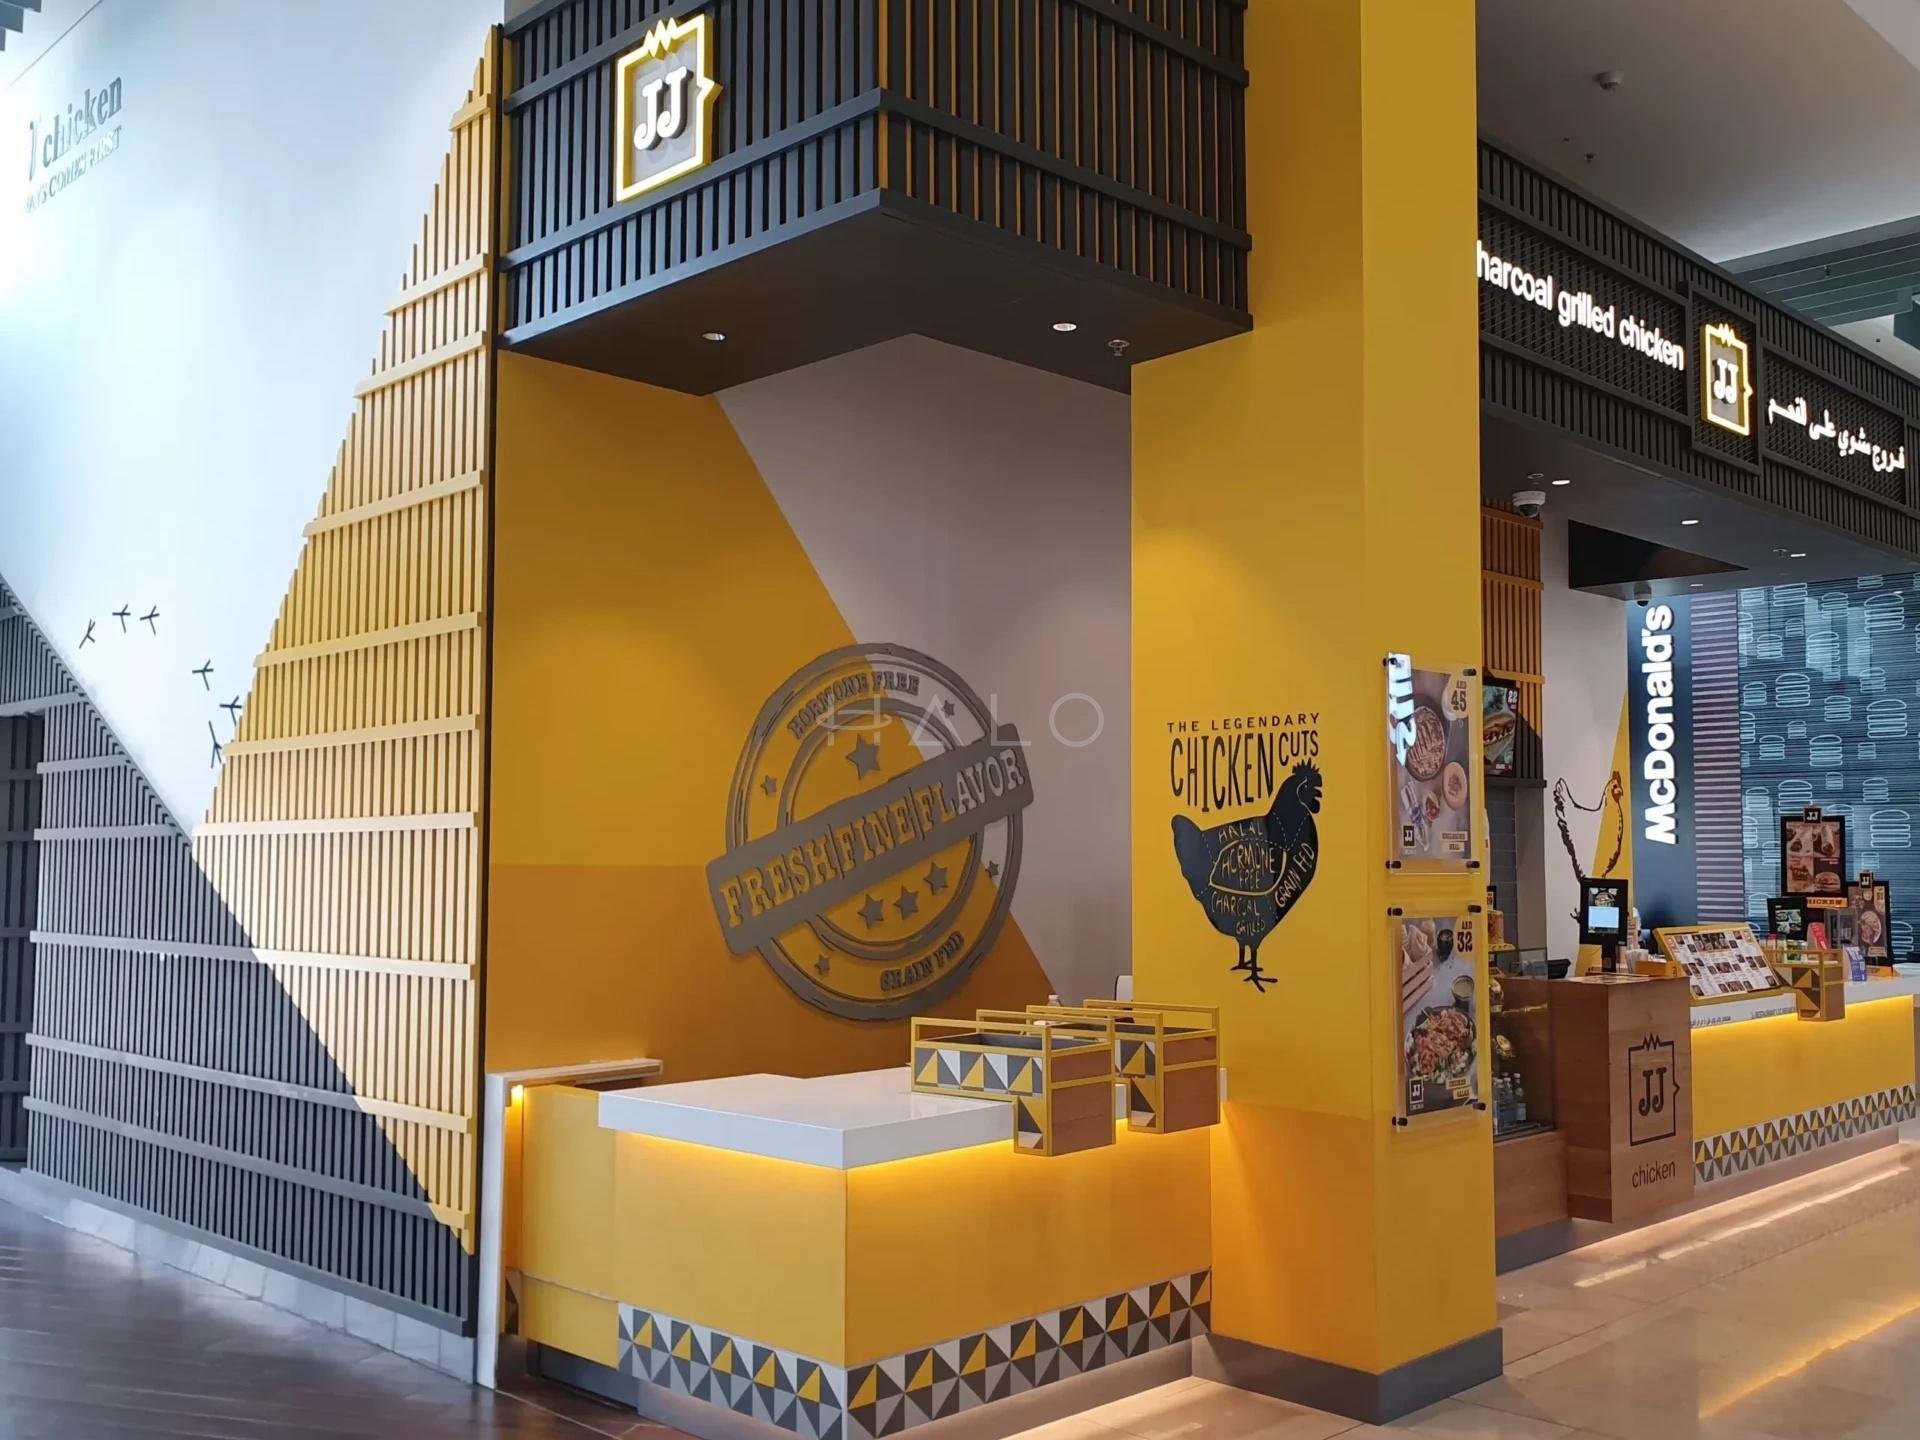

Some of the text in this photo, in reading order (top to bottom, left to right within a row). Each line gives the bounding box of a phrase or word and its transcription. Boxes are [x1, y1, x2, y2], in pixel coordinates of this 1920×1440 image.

[43, 76, 122, 168] chicken
[633, 66, 687, 150] JJ
[1557, 290, 1615, 338] grilled
[1618, 314, 1685, 371] chicken
[1713, 357, 1739, 404] JJ
[1809, 408, 1836, 440] على
[1838, 426, 1871, 457] مشوي
[1871, 445, 1905, 473] فروج
[871, 671, 921, 697] FREE
[1451, 689, 1467, 712] 45
[1167, 712, 1320, 733] THE LEGENDARY
[1641, 604, 1677, 845] McDonald's
[1170, 729, 1320, 812] CHICKEN CUTS
[719, 748, 1025, 929] FRESH FINE FLAVOR
[1218, 820, 1263, 842] HALAL
[1221, 842, 1276, 878] HORMONE
[1274, 842, 1315, 908] GRAIN FED
[880, 930, 967, 993] GRAIN FED
[1457, 931, 1473, 953] 32
[1638, 1067, 1667, 1117] JJ
[1631, 1159, 1677, 1190] chicken
